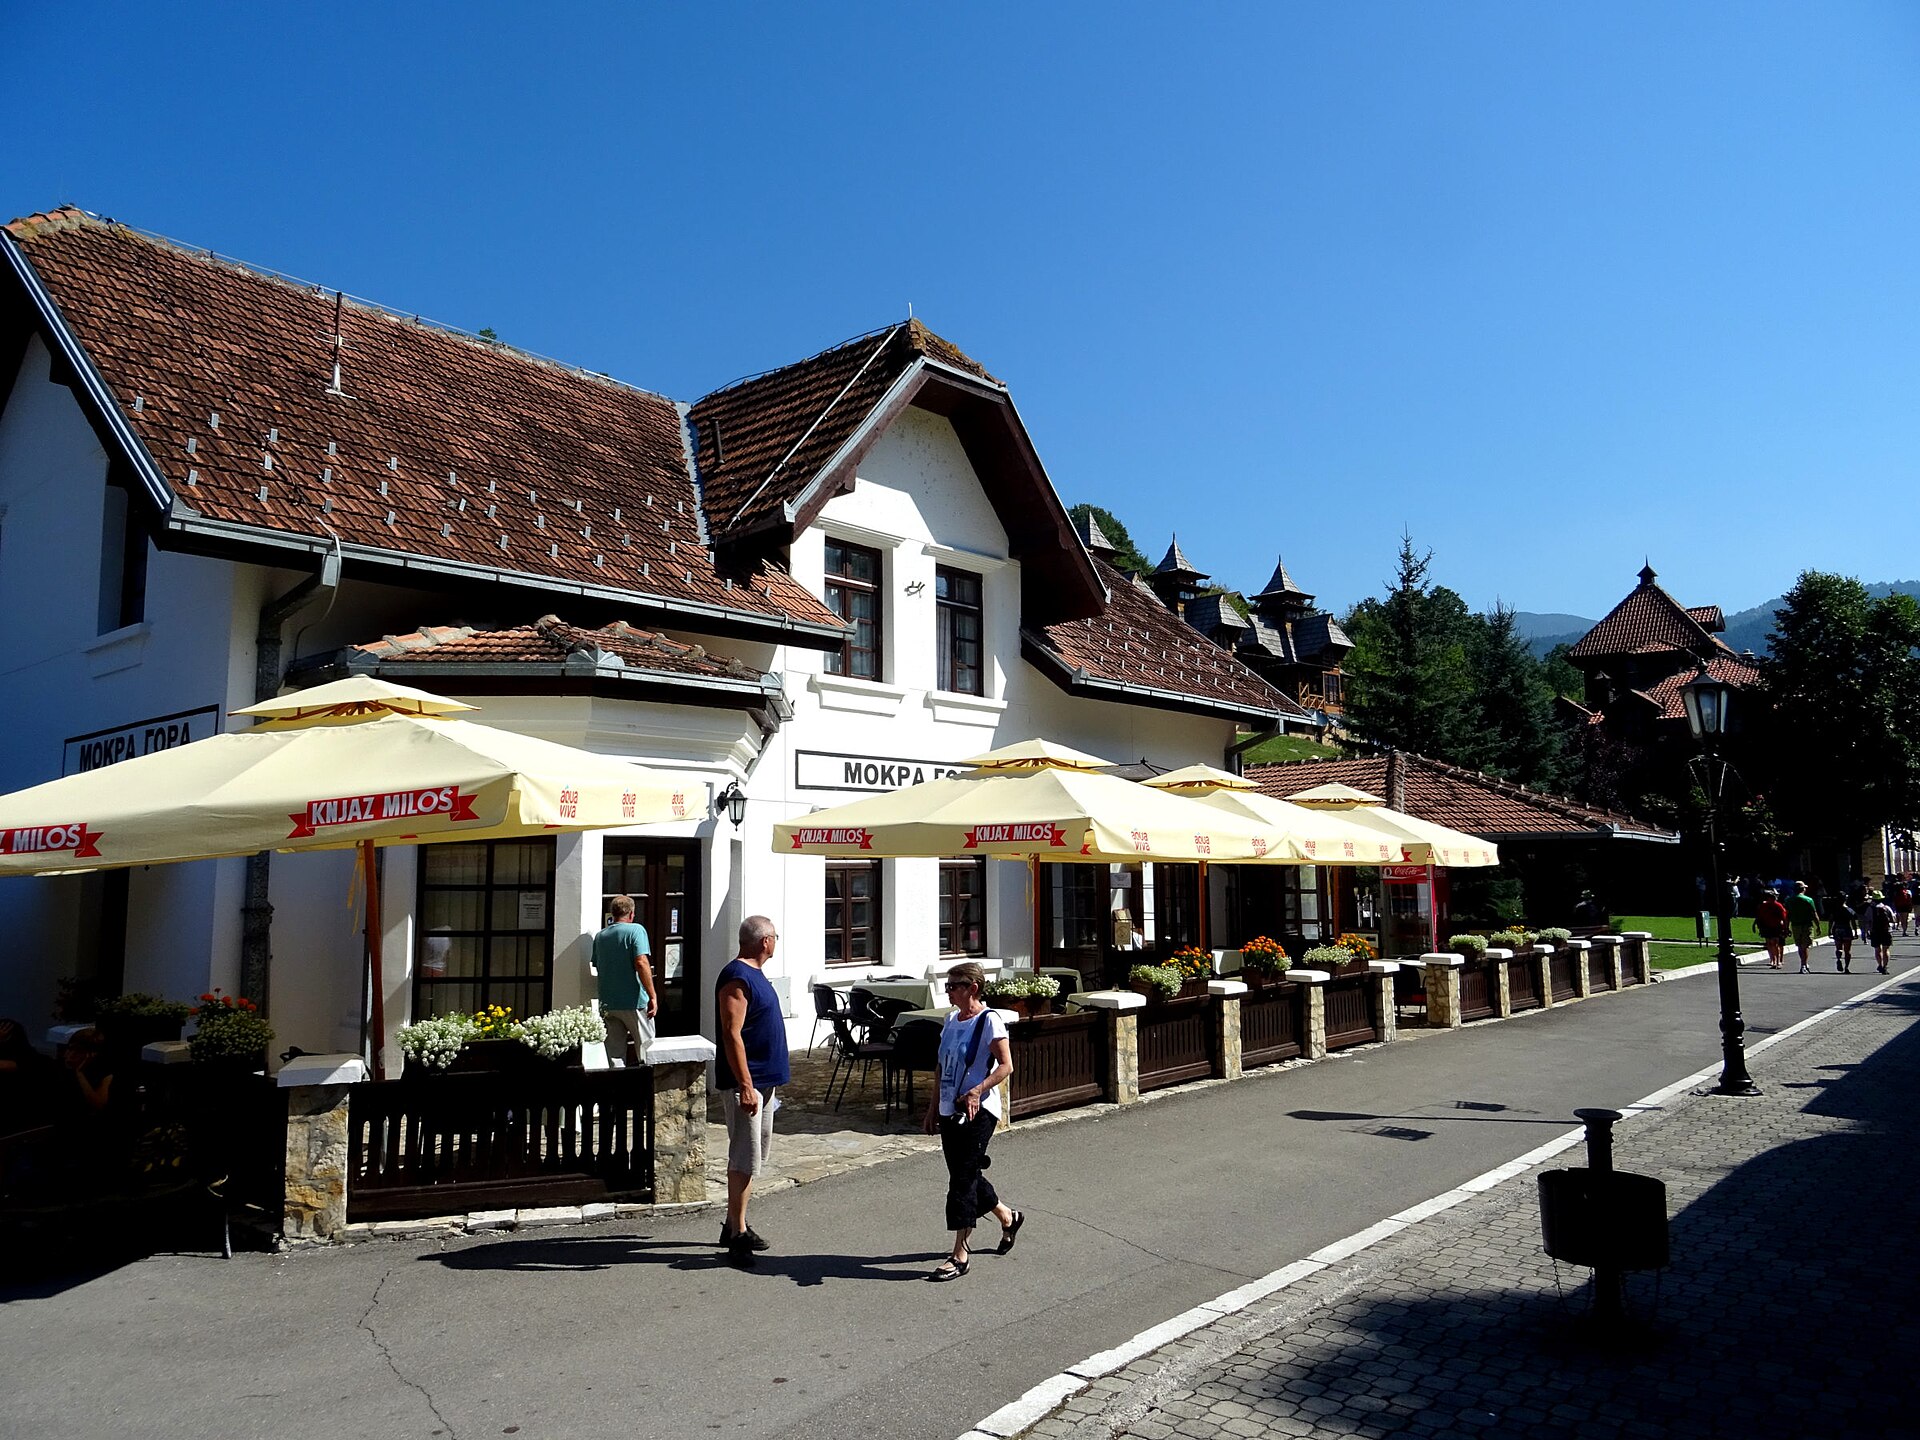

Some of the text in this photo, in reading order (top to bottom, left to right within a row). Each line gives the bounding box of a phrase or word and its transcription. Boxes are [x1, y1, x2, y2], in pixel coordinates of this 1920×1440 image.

[80, 722, 191, 773] МОКРА ГОРА
[844, 762, 925, 787] МОКРА
[560, 789, 579, 804] aqua
[311, 786, 453, 825] KNJAZ MILOŠ
[560, 805, 577, 819] viva
[622, 806, 635, 818] viva
[12, 824, 81, 853] MILOŠ
[800, 829, 829, 843] KNJAZ
[975, 825, 1010, 842] KNJAZ
